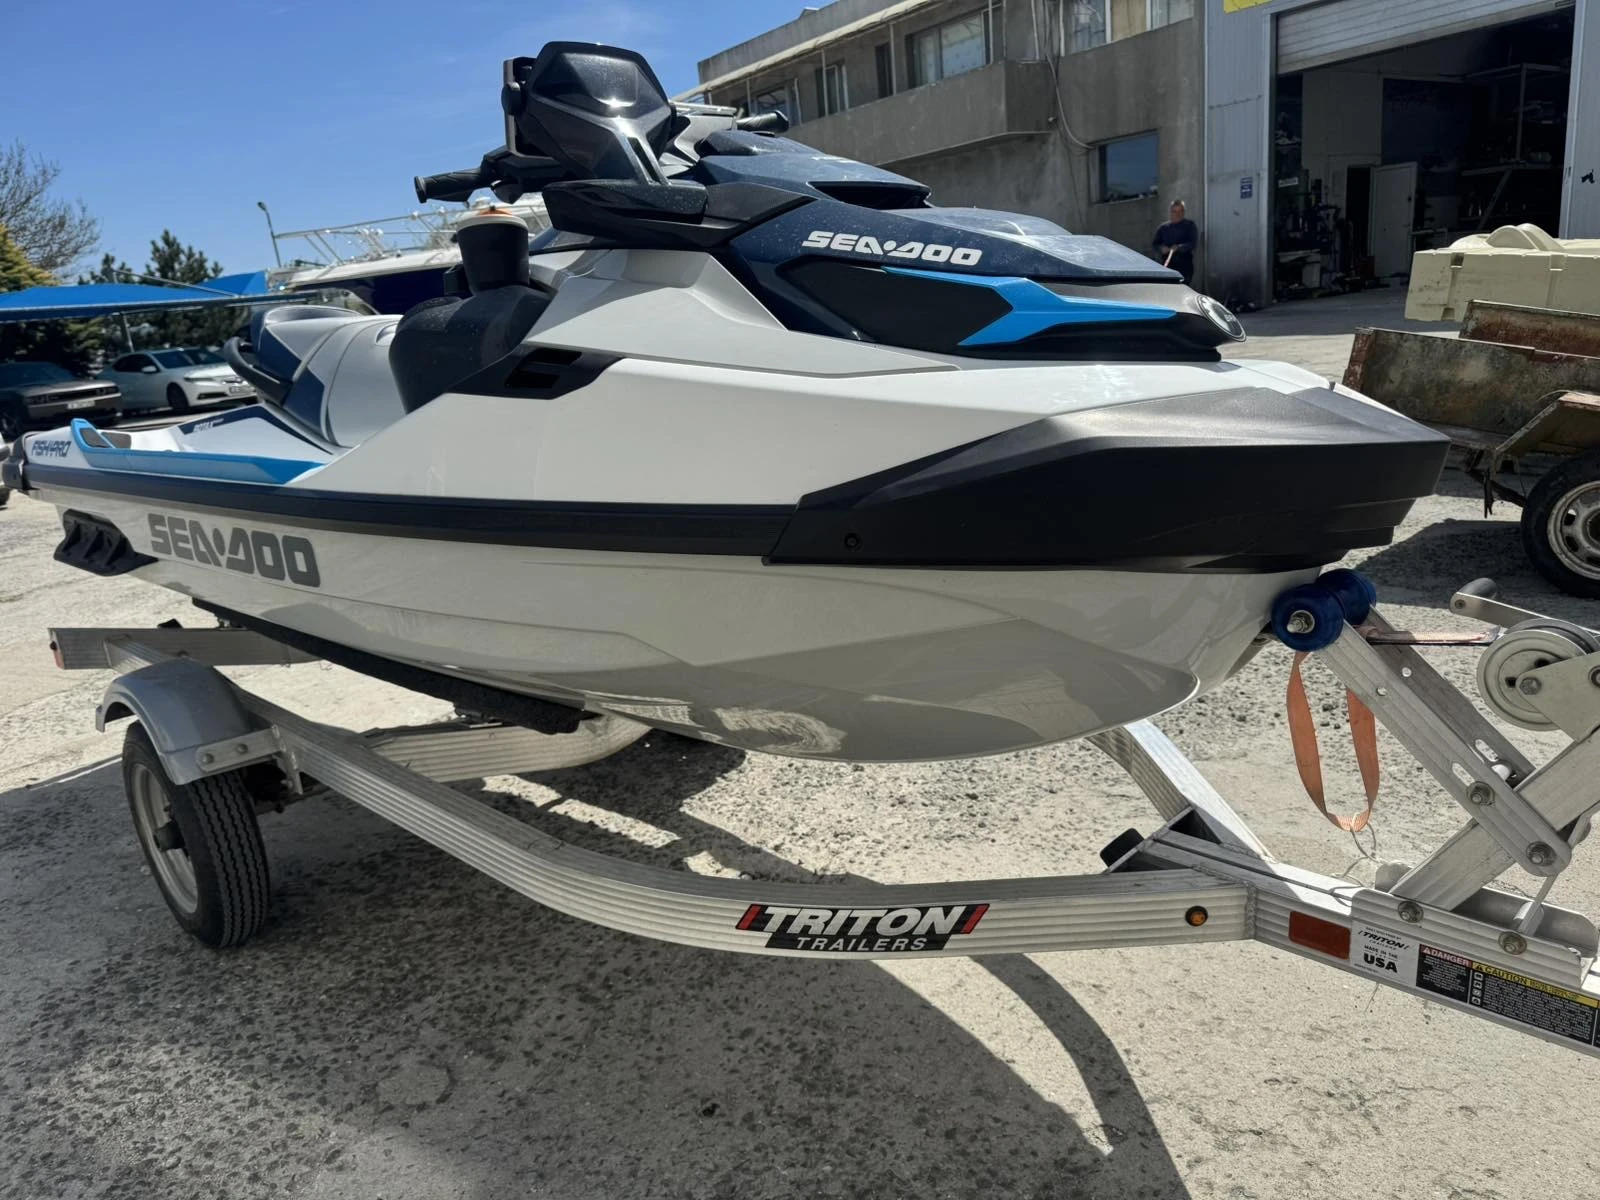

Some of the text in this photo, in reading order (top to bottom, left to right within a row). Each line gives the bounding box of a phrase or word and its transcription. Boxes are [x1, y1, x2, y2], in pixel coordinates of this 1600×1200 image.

[764, 905, 966, 936] TRITON
[796, 936, 928, 951] TRAILERS
[1363, 931, 1405, 949] TRITON
[1363, 953, 1398, 974] USA
[1431, 949, 1470, 967] DANGER
[1484, 966, 1528, 985] CAUTION
